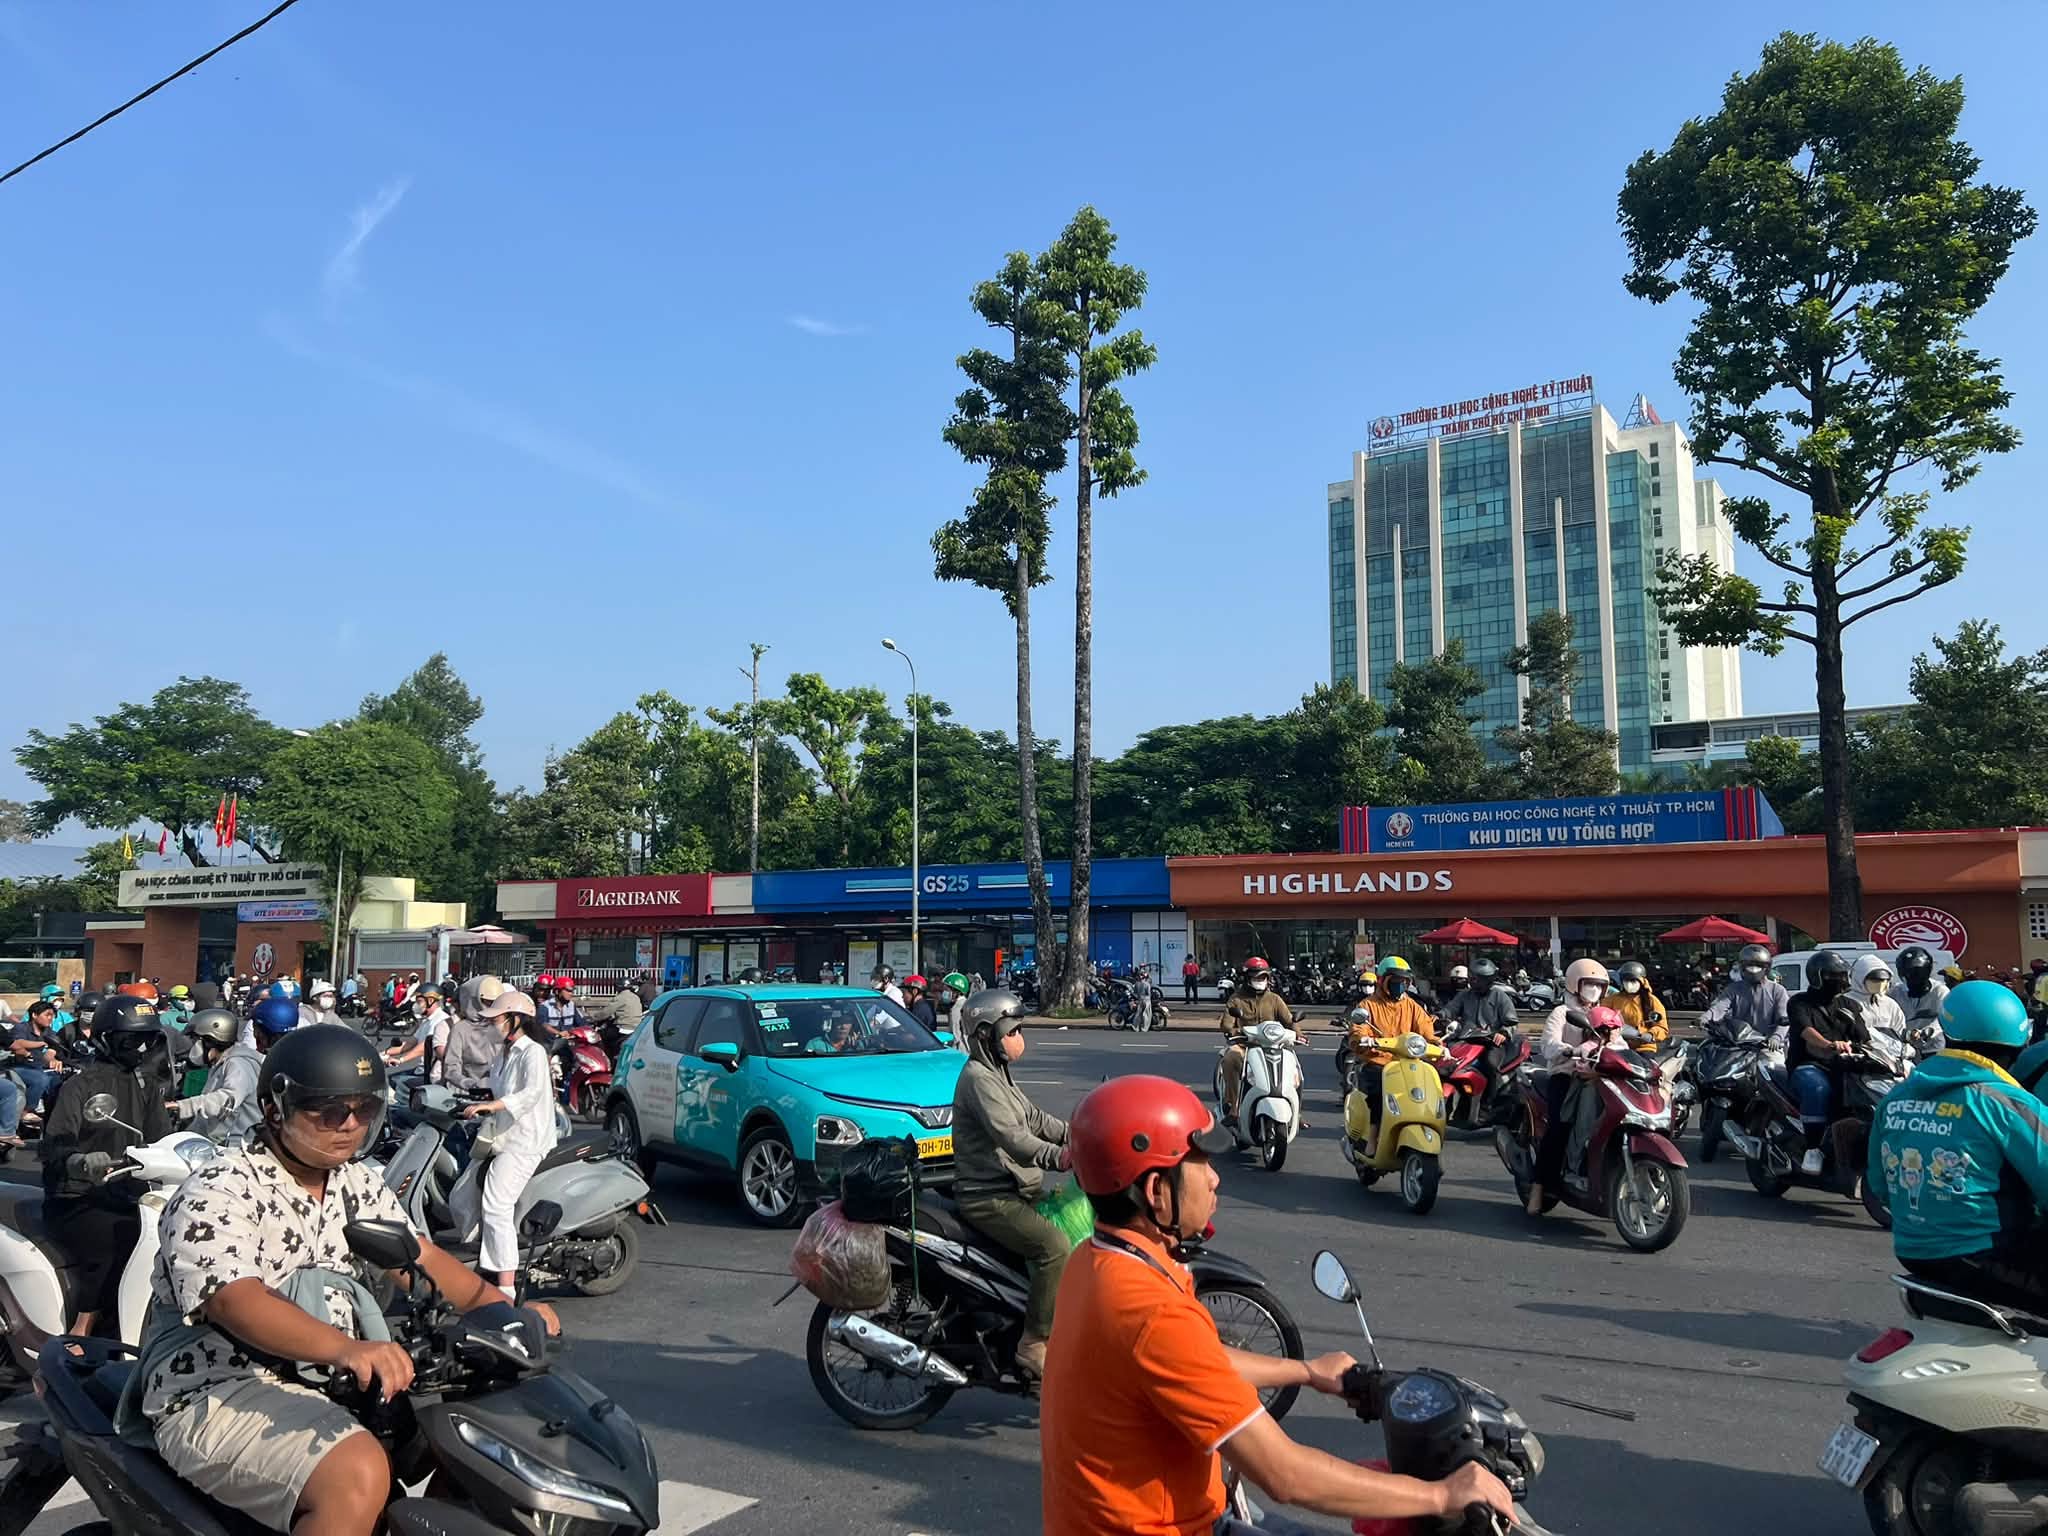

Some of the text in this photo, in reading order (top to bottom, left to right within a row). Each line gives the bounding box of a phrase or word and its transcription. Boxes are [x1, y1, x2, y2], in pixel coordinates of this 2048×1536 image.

[1460, 399, 1479, 416] HỌC
[1482, 392, 1509, 409] CÔNG
[1512, 384, 1538, 402] NGHỆ
[1525, 404, 1550, 419] MINH
[1422, 809, 1469, 825] TRƯỜNG
[1473, 810, 1492, 824] ĐẠI
[1495, 808, 1521, 822] HỌC
[1524, 805, 1559, 820] CÔNG
[1563, 803, 1596, 819] NGHỆ
[1600, 802, 1617, 816] KỸ
[1621, 801, 1661, 816] THUẬT
[1469, 819, 1655, 846] KHU DỊCH VỤ TỔNG HỢP
[923, 874, 969, 893] GS25
[1243, 869, 1454, 895] HIGHLANDS
[595, 889, 682, 907] AGRIBANK
[1875, 909, 1960, 936] HIGHLANDS
[764, 1023, 790, 1032] TAXI
[1886, 1099, 1965, 1118] GREEN SM
[1884, 1115, 1905, 1131] Xin
